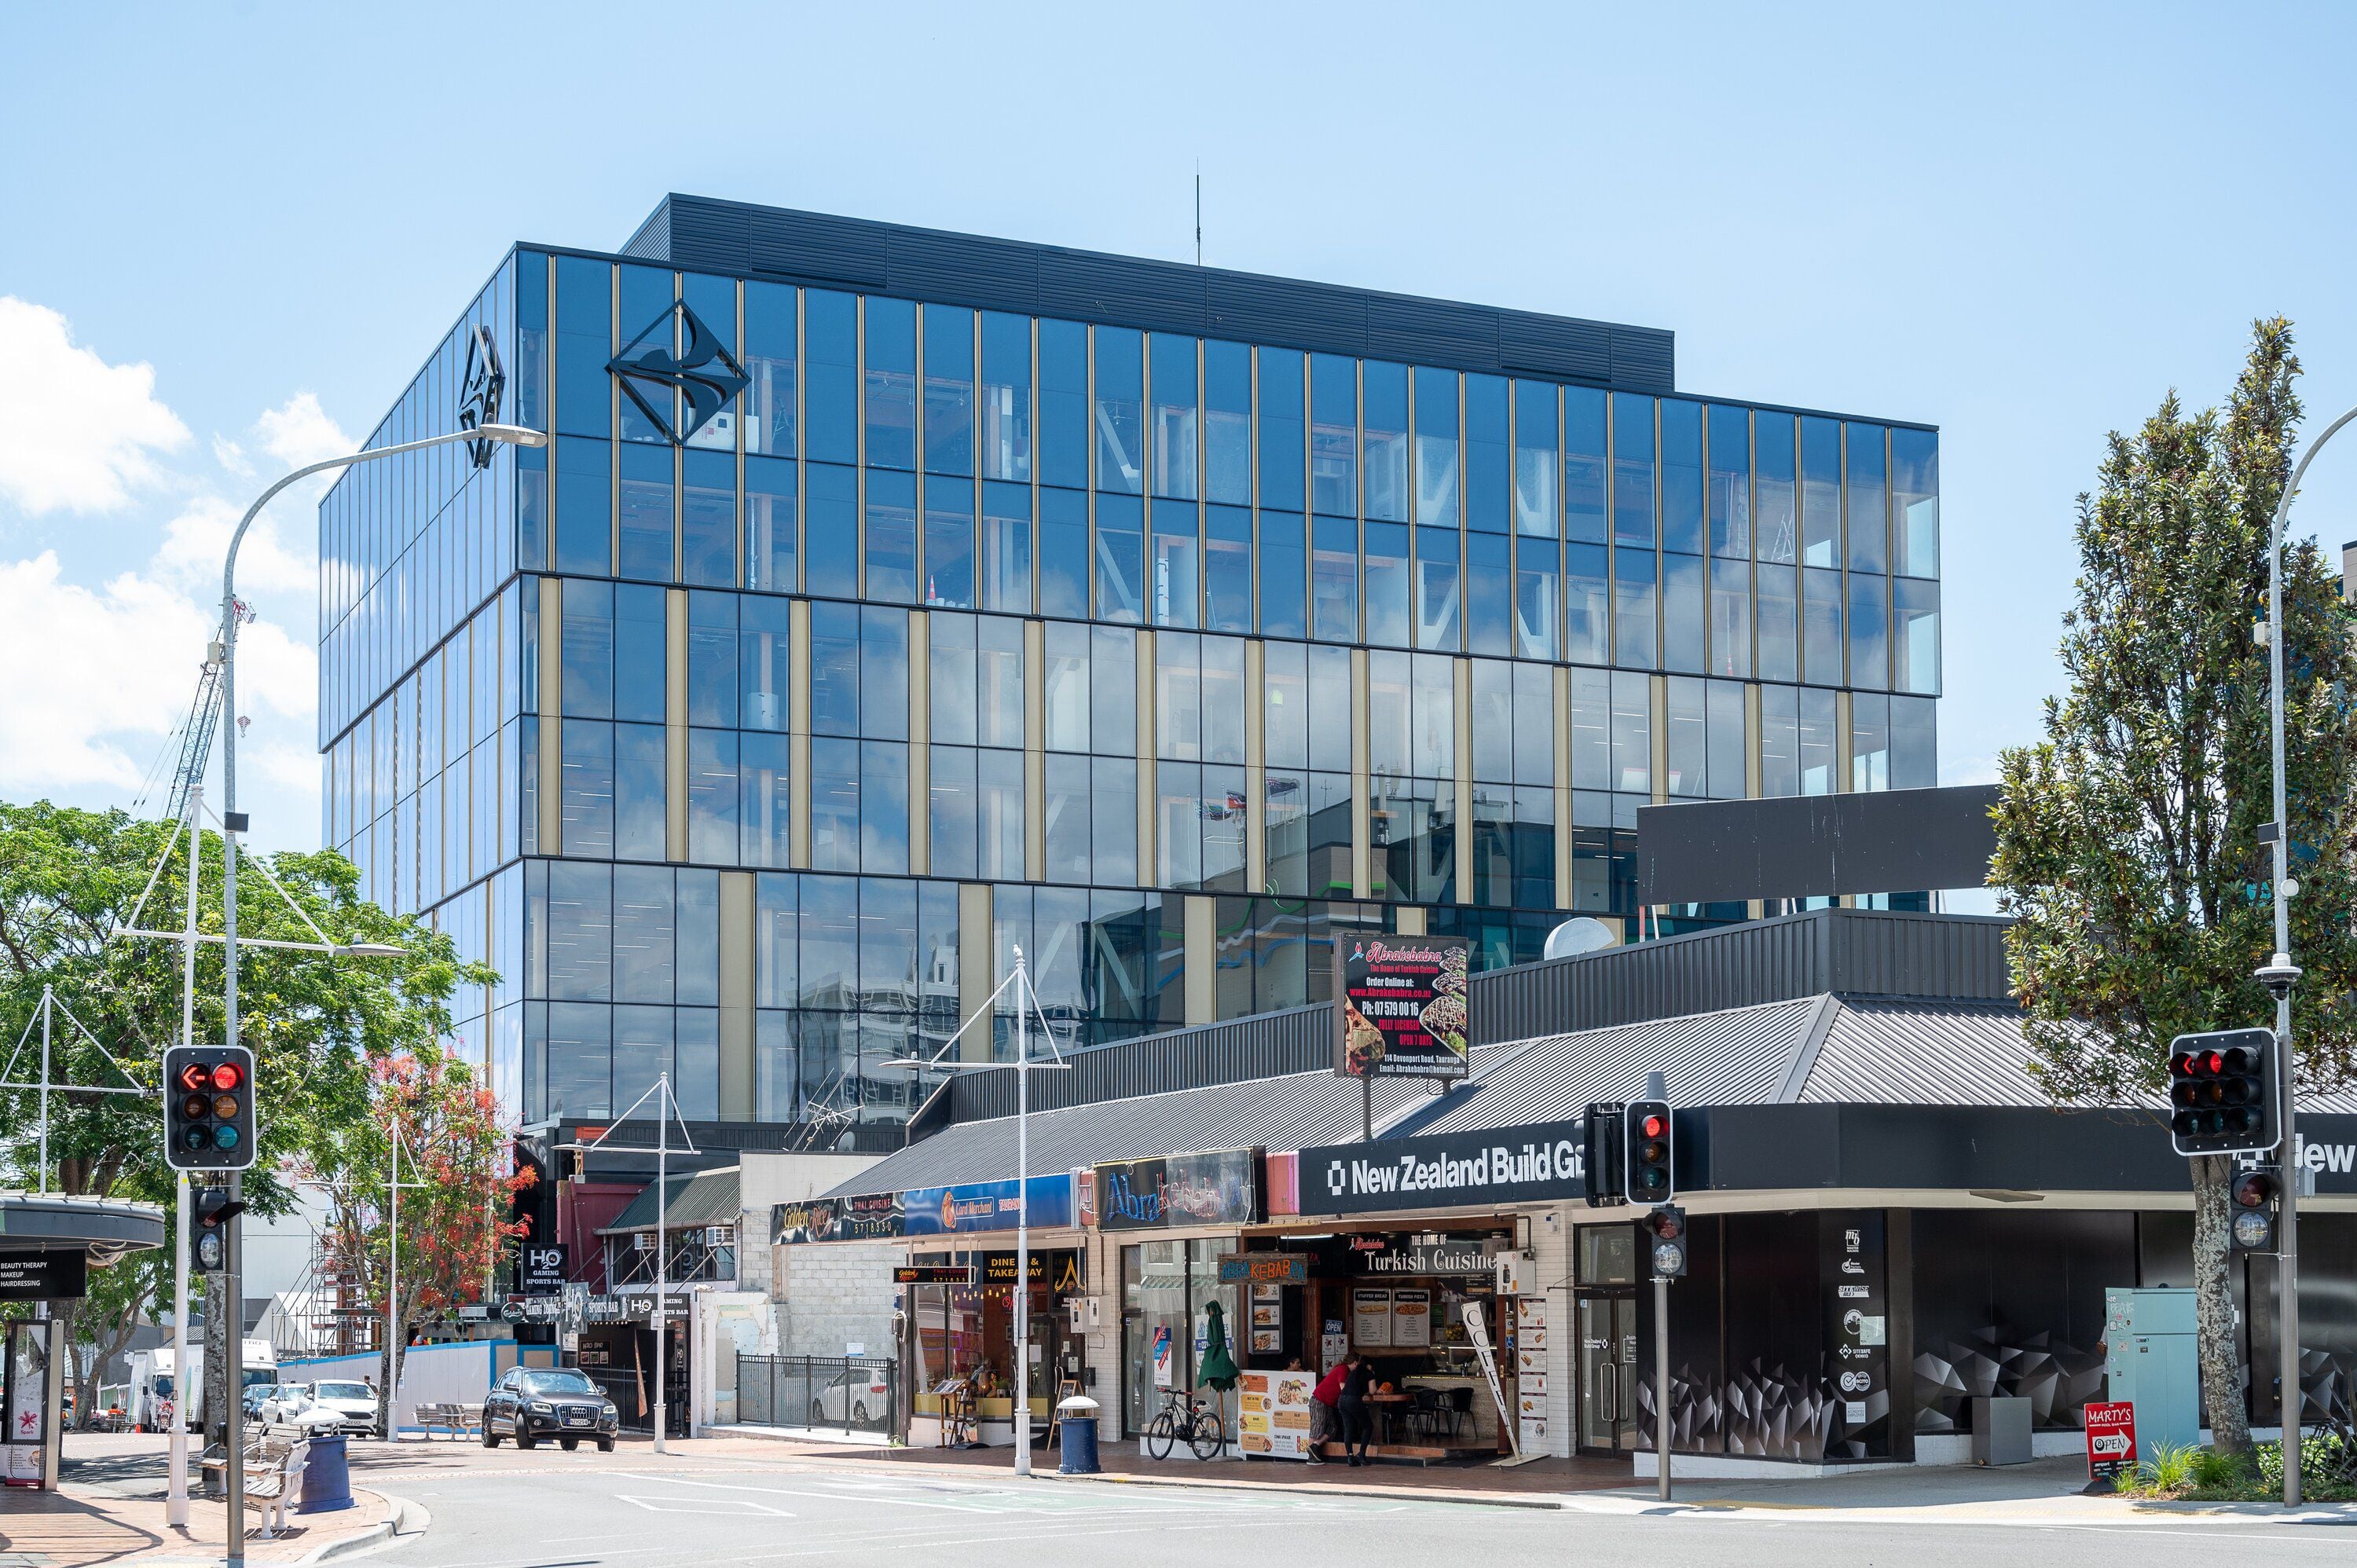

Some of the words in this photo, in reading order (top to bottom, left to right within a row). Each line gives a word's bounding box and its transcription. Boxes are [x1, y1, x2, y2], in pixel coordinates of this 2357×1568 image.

[1366, 942, 1442, 963] Abrakebabra
[1380, 964, 1394, 973] Home
[1401, 965, 1419, 973] Turkish
[1420, 965, 1439, 974] Cuisine
[1366, 977, 1384, 987] Order
[1385, 977, 1405, 987] Online
[1349, 987, 1431, 998] www.Abrakebabra.co.nz
[1362, 1001, 1374, 1015] Ph:
[1374, 1002, 1384, 1015] 07
[1385, 1002, 1398, 1016] 579
[1399, 1002, 1408, 1016] 00
[1410, 1002, 1419, 1016] 16
[1378, 1019, 1394, 1030] FULLY
[1395, 1020, 1420, 1031] LICENSED
[1399, 1034, 1413, 1045] OPEN
[1415, 1035, 1418, 1045] 7
[1419, 1035, 1433, 1046] DAYS
[1393, 1054, 1420, 1063] Devonport
[1421, 1055, 1435, 1063] Road,
[1436, 1055, 1459, 1064] Tauranga
[1379, 1064, 1395, 1073] Email:
[1396, 1065, 1465, 1074] Abrakebabra@hotmail.com
[1352, 1160, 1398, 1194] New
[1401, 1149, 1488, 1191] Zealand
[1492, 1142, 1551, 1184] Build
[854, 1201, 866, 1211] THAI
[868, 1198, 890, 1209] CUISINE
[956, 1203, 968, 1215] Card
[969, 1201, 992, 1214] Merchant
[784, 1207, 808, 1227] Golden
[809, 1207, 828, 1238] Rice
[855, 1221, 892, 1233] 5718330
[1412, 1235, 1421, 1245] THE
[1422, 1235, 1438, 1245] HOME
[1439, 1234, 1447, 1245] OF
[530, 1249, 561, 1269] H2O
[991, 1258, 1015, 1266] DINE
[1031, 1258, 1039, 1266] &
[1364, 1247, 1426, 1271] Turkish
[1433, 1249, 1497, 1271] Cuisine
[1222, 1260, 1304, 1281] ABRAKEBABRA
[526, 1304, 542, 1315] GAMING
[589, 1302, 607, 1313] SPORTS
[608, 1301, 618, 1312] BAR
[1327, 1324, 1341, 1332] OPEN
[2088, 1408, 2131, 1423] MARTY'S
